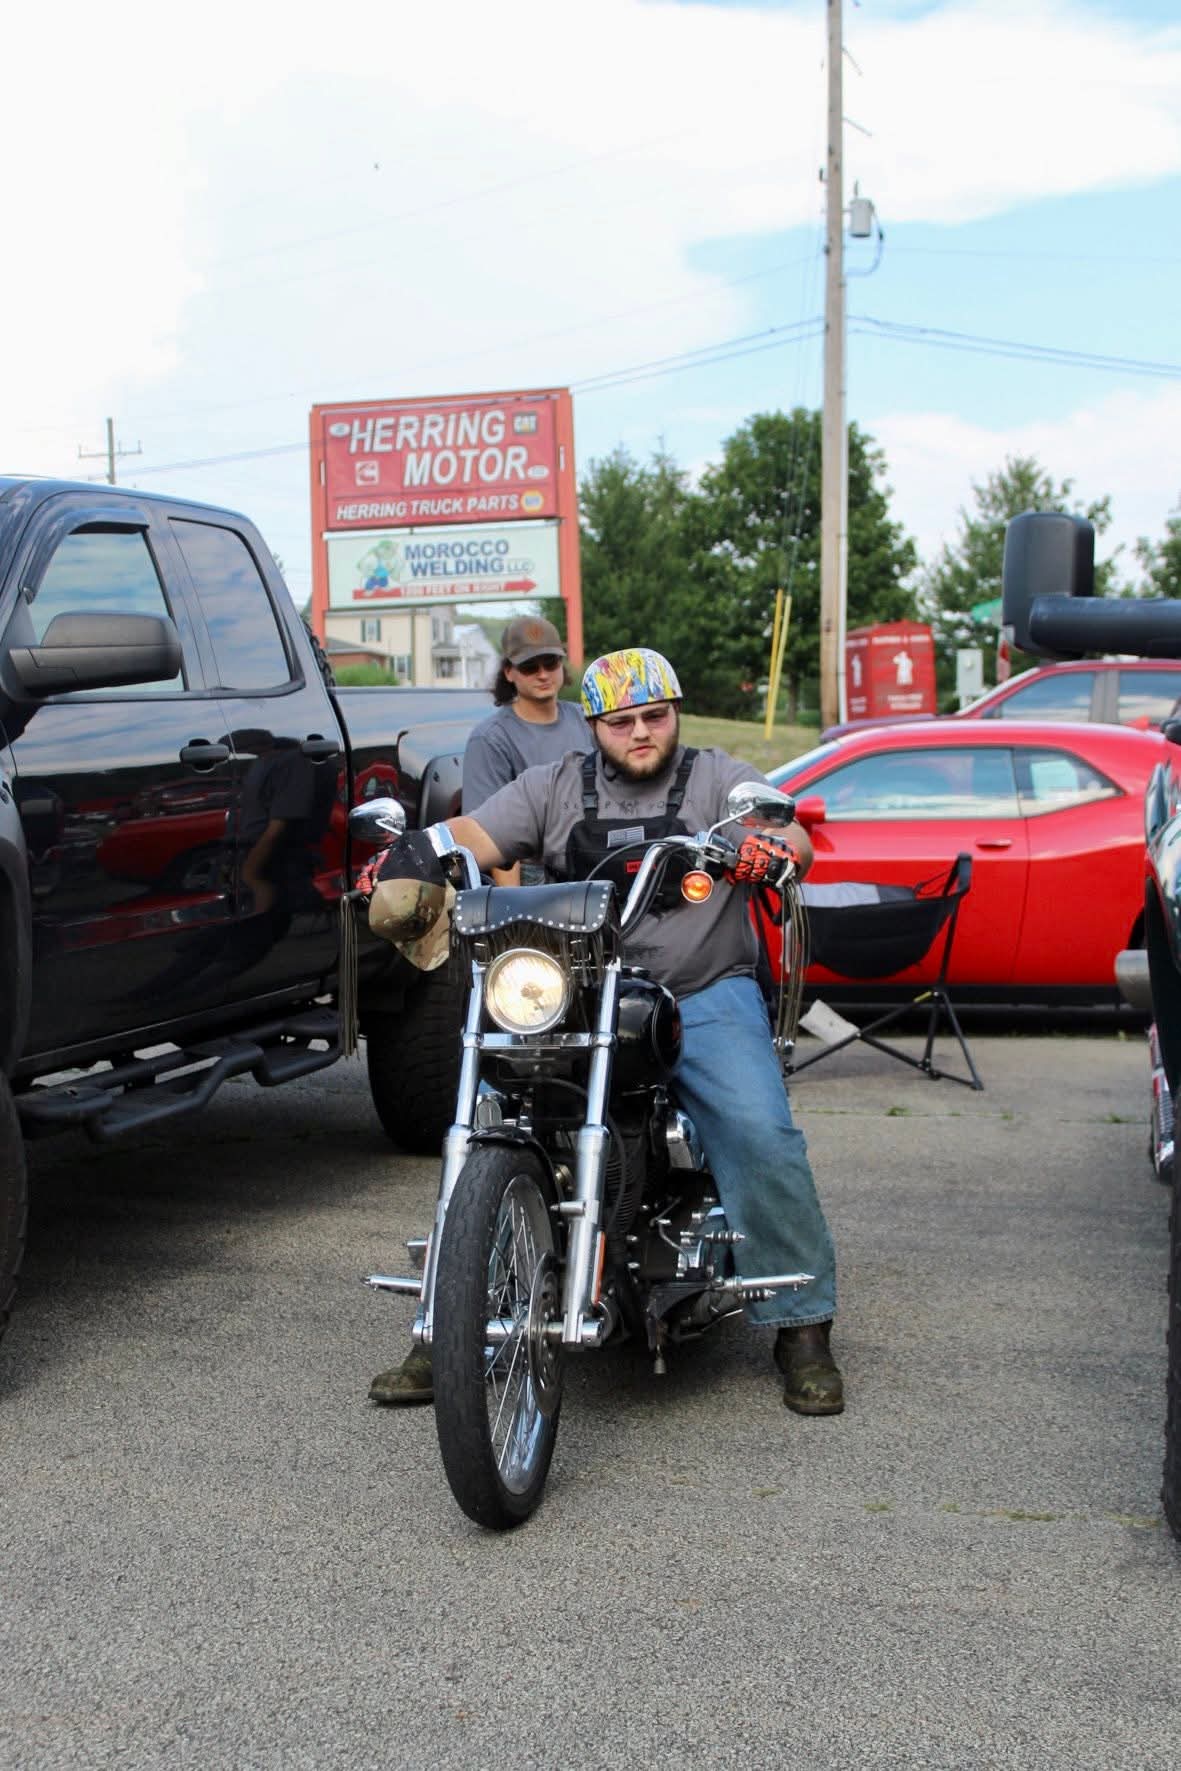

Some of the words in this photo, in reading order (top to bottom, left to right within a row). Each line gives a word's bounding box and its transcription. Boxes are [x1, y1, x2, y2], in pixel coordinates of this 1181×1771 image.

[349, 410, 506, 454] HERRING
[403, 446, 529, 487] MOTOR
[336, 500, 406, 520] HERRING
[410, 497, 463, 516] TRUCK
[466, 494, 519, 513] PARTS
[405, 539, 510, 561] MOROCCO
[410, 557, 505, 577] WELDING
[506, 560, 530, 573] LLC
